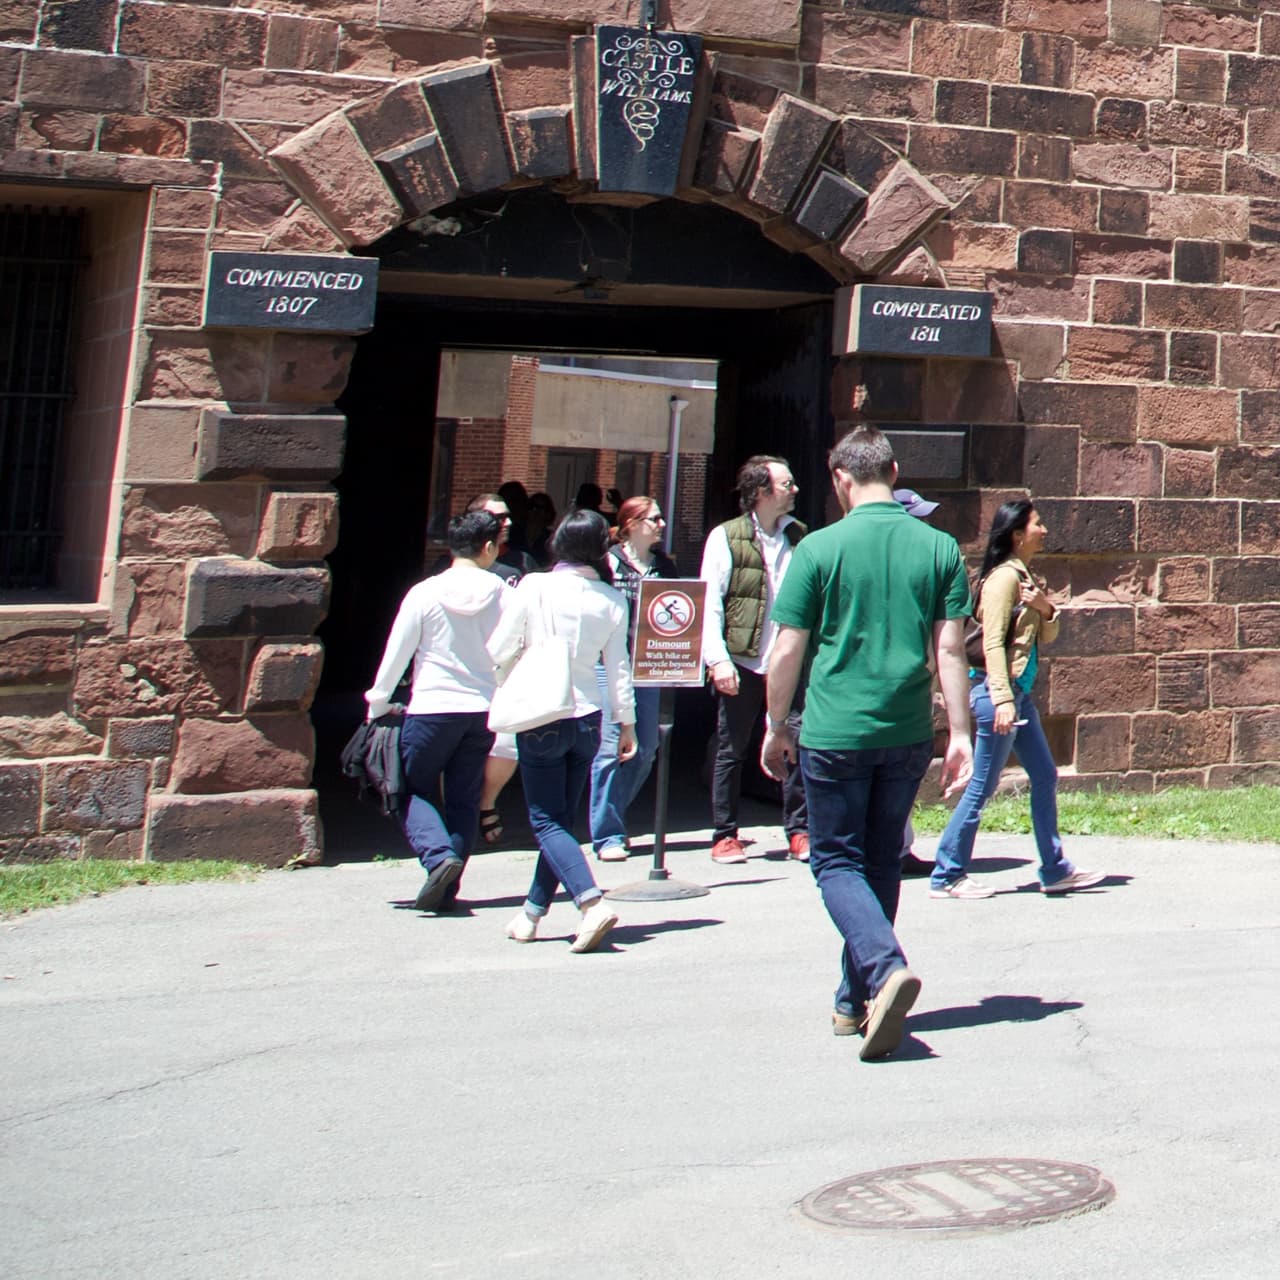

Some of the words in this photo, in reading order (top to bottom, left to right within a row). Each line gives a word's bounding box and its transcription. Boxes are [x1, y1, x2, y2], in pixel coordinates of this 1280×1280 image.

[601, 48, 694, 75] CASTLE
[600, 79, 692, 104] WILLIAMS
[226, 268, 363, 291] COMMENCED
[265, 296, 319, 315] 1807
[872, 300, 981, 321] COMPLEATED
[910, 325, 941, 342] 1811
[647, 639, 691, 650] Dismount
[638, 660, 668, 670] unicycle
[668, 660, 697, 670] beyond
[645, 651, 664, 660] Walk
[664, 651, 680, 660] bike
